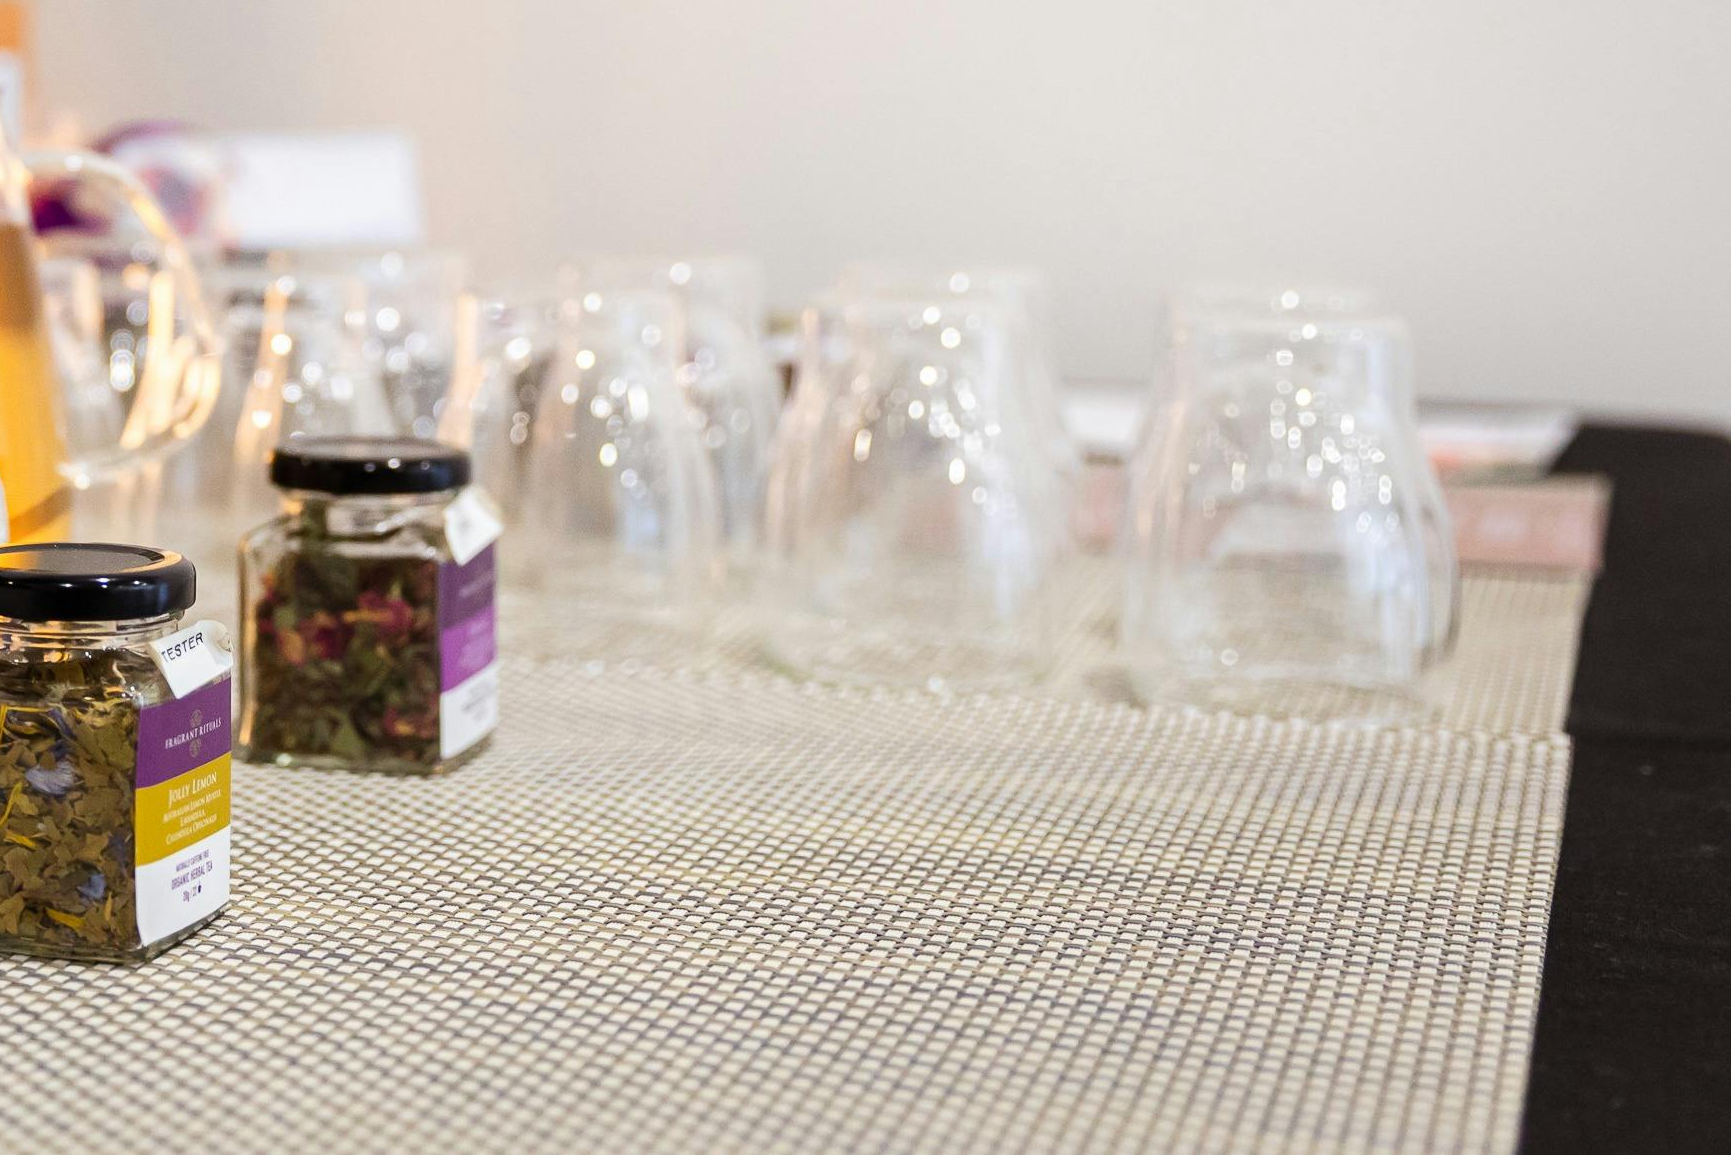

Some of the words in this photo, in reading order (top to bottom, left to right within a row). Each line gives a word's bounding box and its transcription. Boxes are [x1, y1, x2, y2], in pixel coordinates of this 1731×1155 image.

[161, 632, 204, 662] TESTER
[165, 727, 198, 749] FRAGRANT
[199, 717, 222, 736] RITUALS
[168, 784, 189, 808] JOLLY
[193, 772, 217, 794] LEMON
[171, 872, 189, 890] ORGANIC
[190, 865, 205, 881] HERBAL
